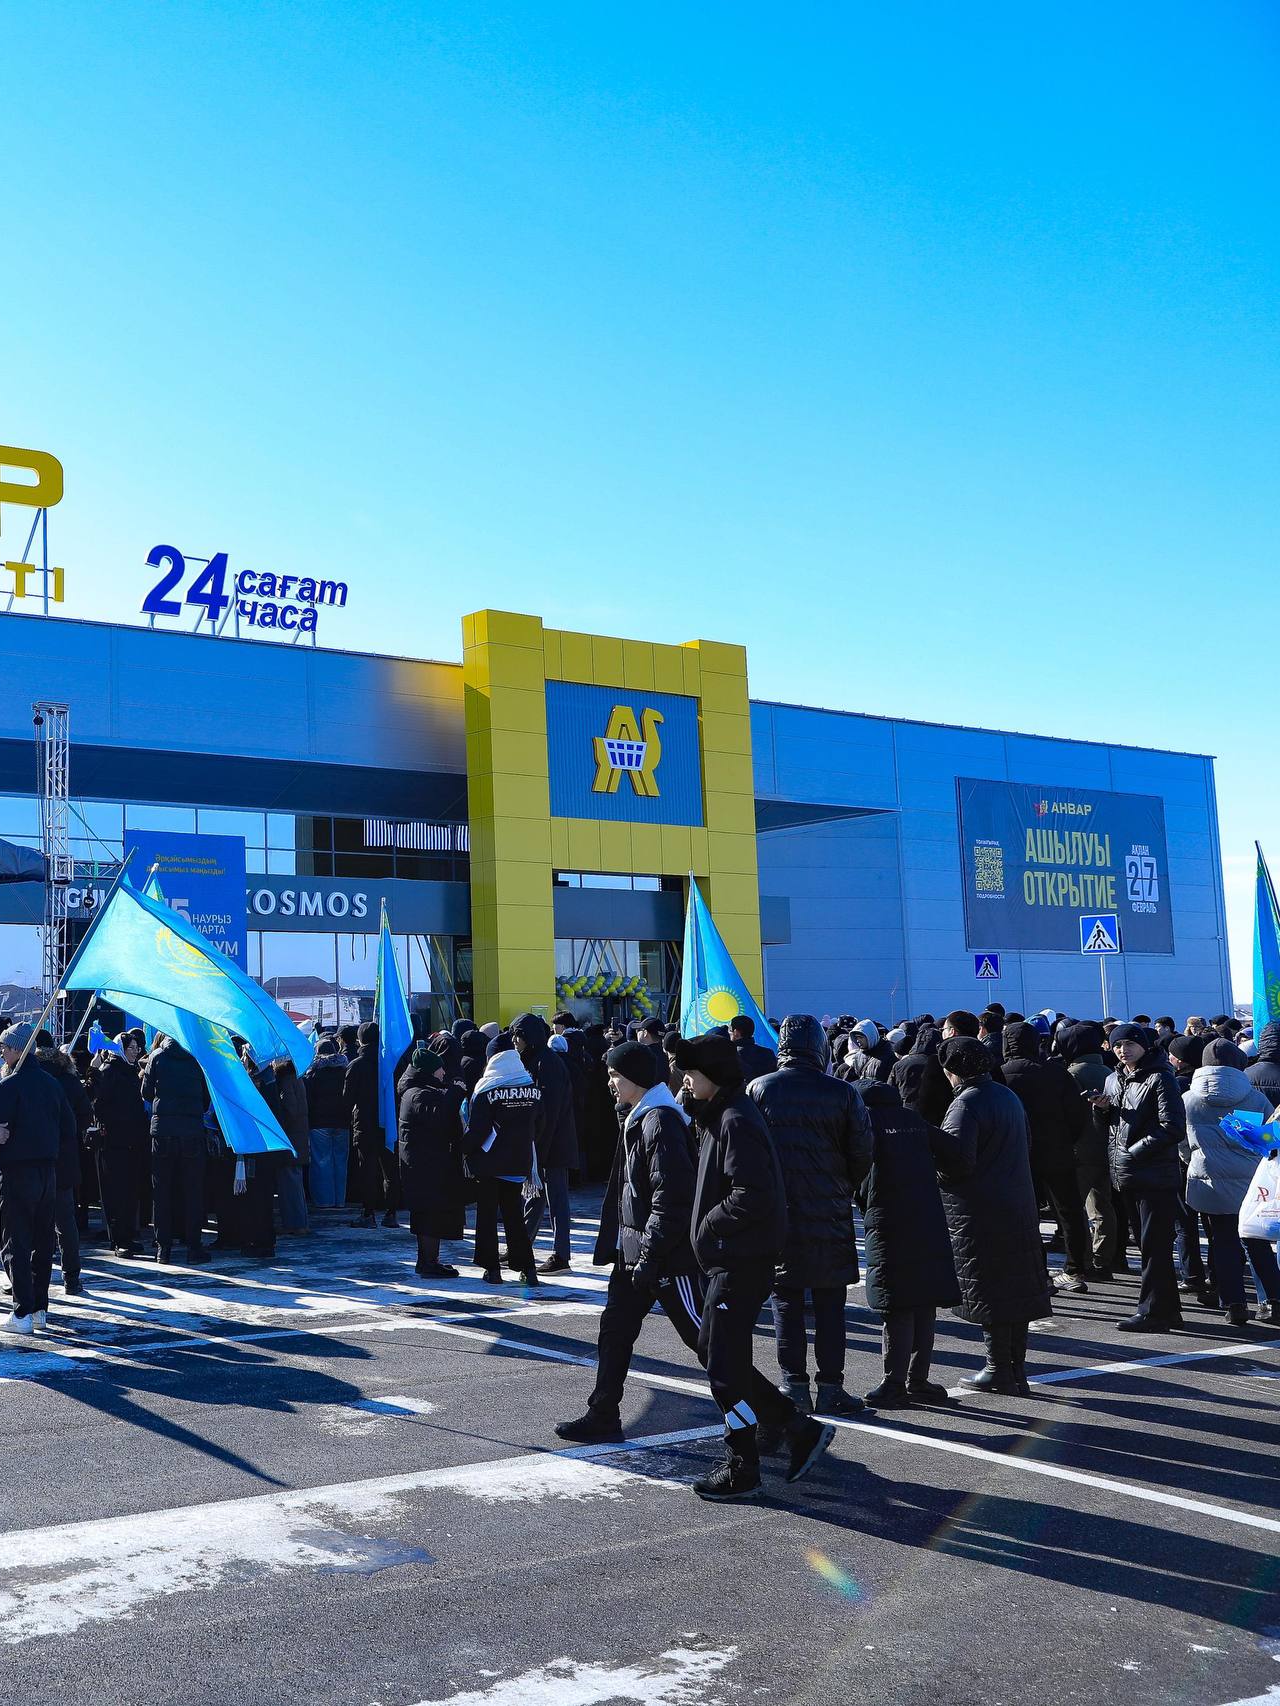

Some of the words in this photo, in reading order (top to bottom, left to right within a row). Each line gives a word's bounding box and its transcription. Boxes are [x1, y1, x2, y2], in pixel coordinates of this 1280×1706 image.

[141, 544, 229, 621] 24
[237, 600, 319, 632] часа
[1051, 801, 1092, 816] АНВАР
[1025, 828, 1111, 867] АШЫЛУЫ
[1023, 870, 1118, 909] ОТКРЫТИЕ
[1127, 860, 1156, 897] 27
[192, 914, 232, 924] НАУРЫЗ
